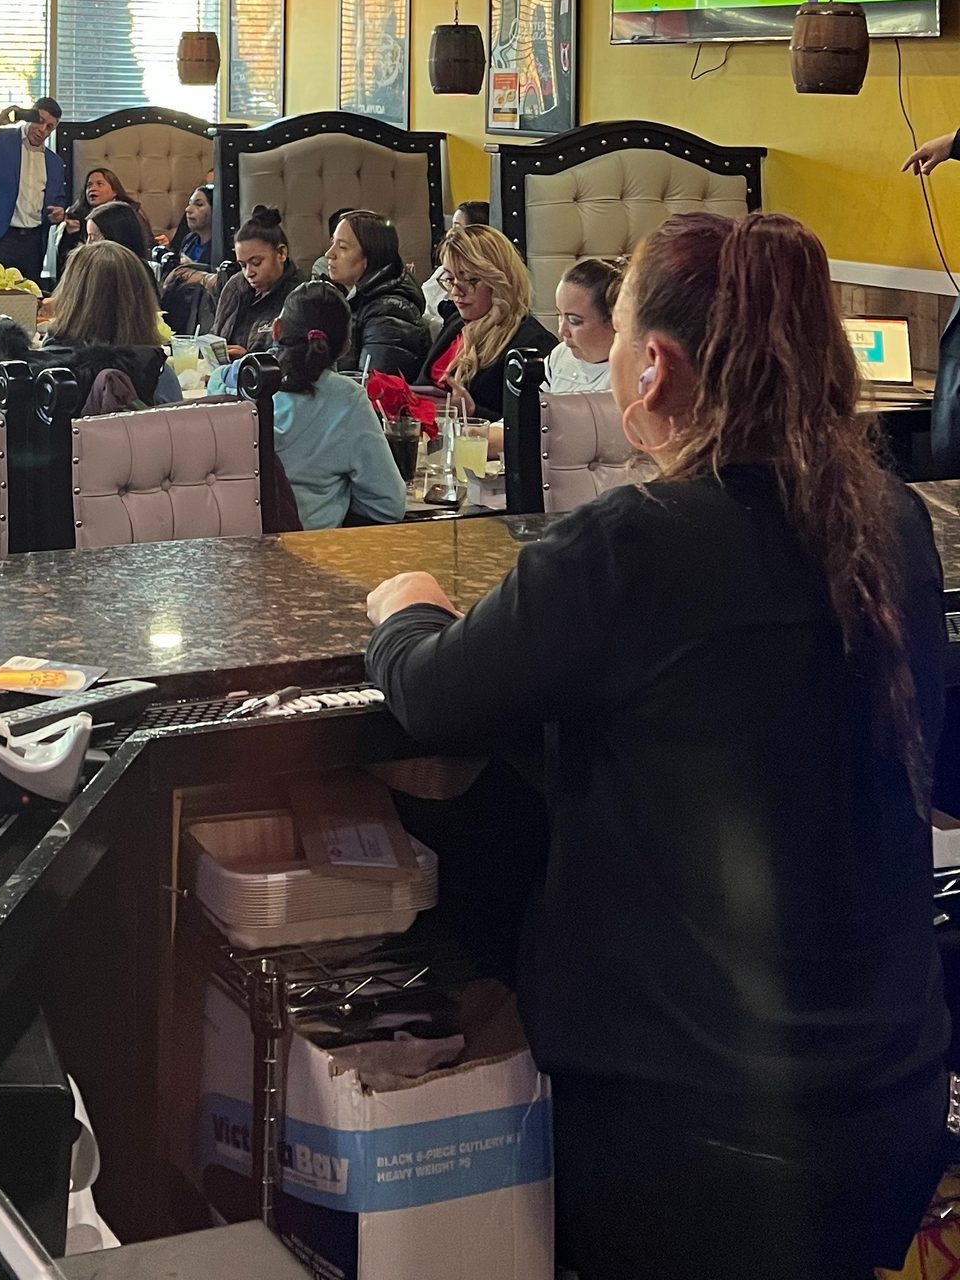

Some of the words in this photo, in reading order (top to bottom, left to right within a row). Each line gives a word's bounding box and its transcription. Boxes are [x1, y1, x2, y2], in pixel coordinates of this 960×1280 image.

[376, 1152, 413, 1168] BLACK
[458, 1134, 505, 1153] CUTLERY
[376, 1168, 413, 1183] HEAVY
[415, 1160, 455, 1177] WEIGHT
